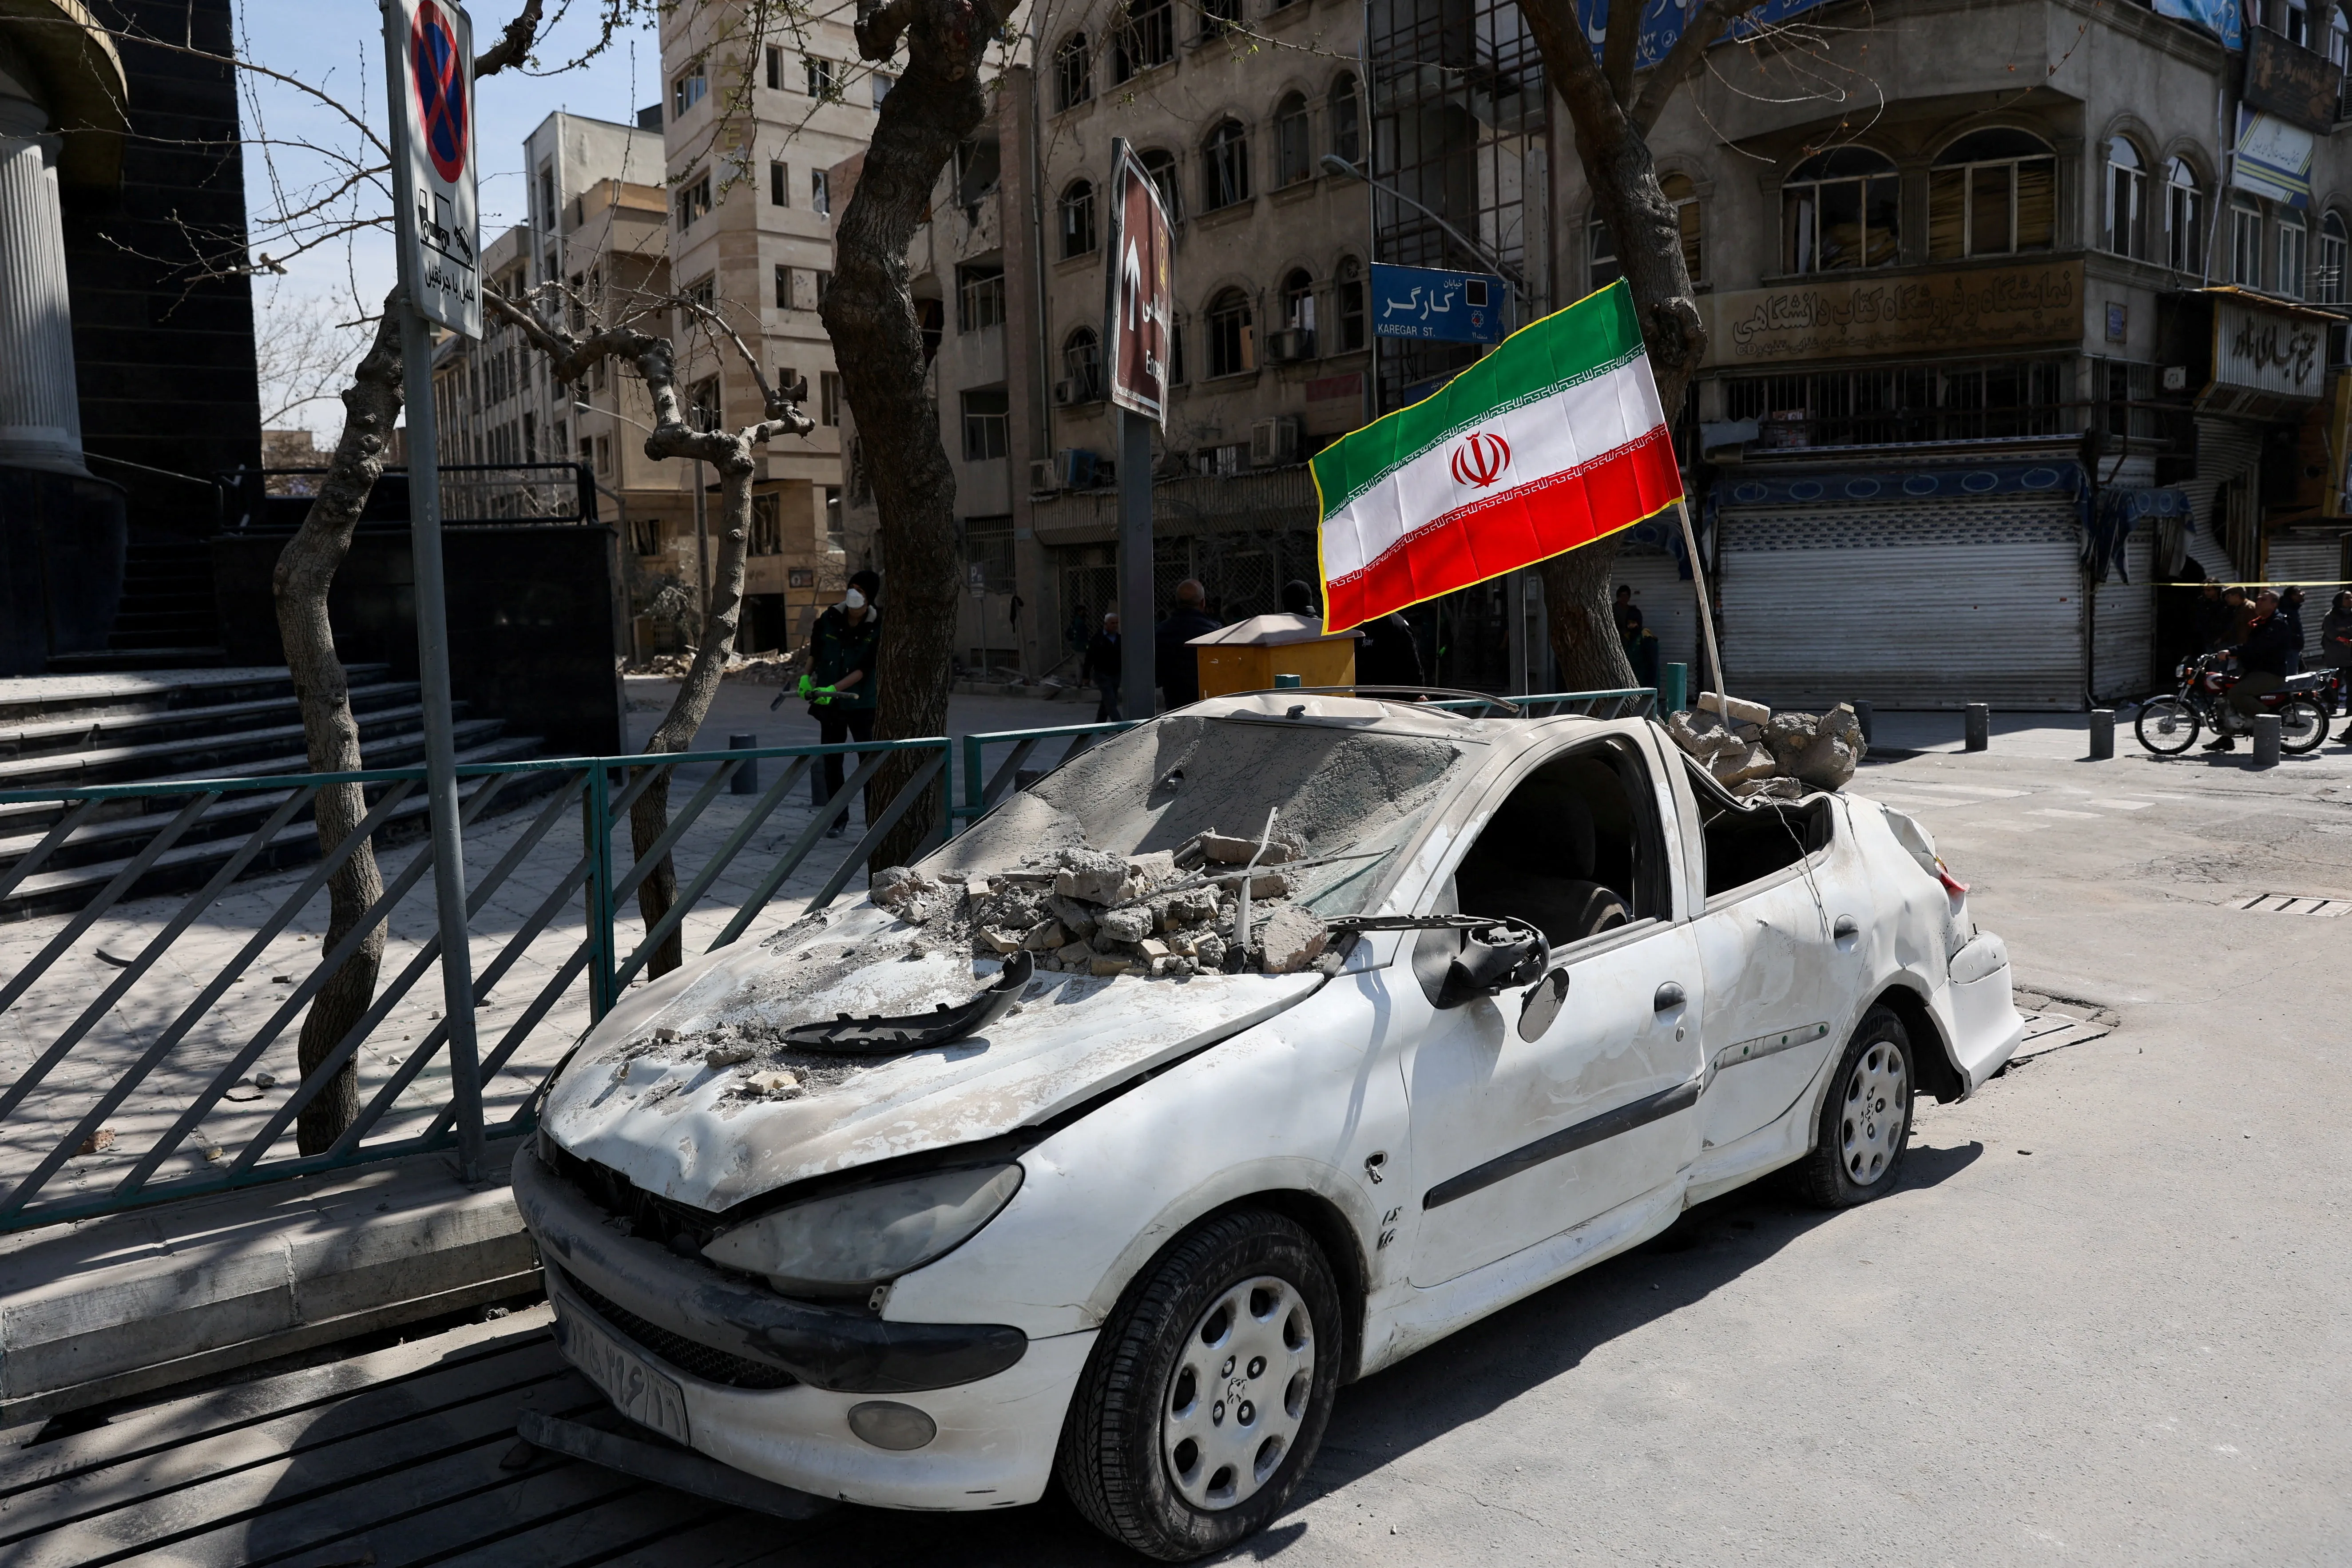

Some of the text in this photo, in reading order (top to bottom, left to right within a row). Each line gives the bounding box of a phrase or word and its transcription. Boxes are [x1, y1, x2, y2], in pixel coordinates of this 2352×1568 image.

[425, 261, 474, 304] حمل با جرثقیل
[1444, 279, 1463, 289] خیابان
[1383, 286, 1454, 320] کارگر
[1733, 270, 2073, 344] نمایشگاه و فروشگاه کتاب دانشگاهی
[1378, 323, 1436, 337] KAREGAR ST.
[1735, 343, 1757, 356] CD
